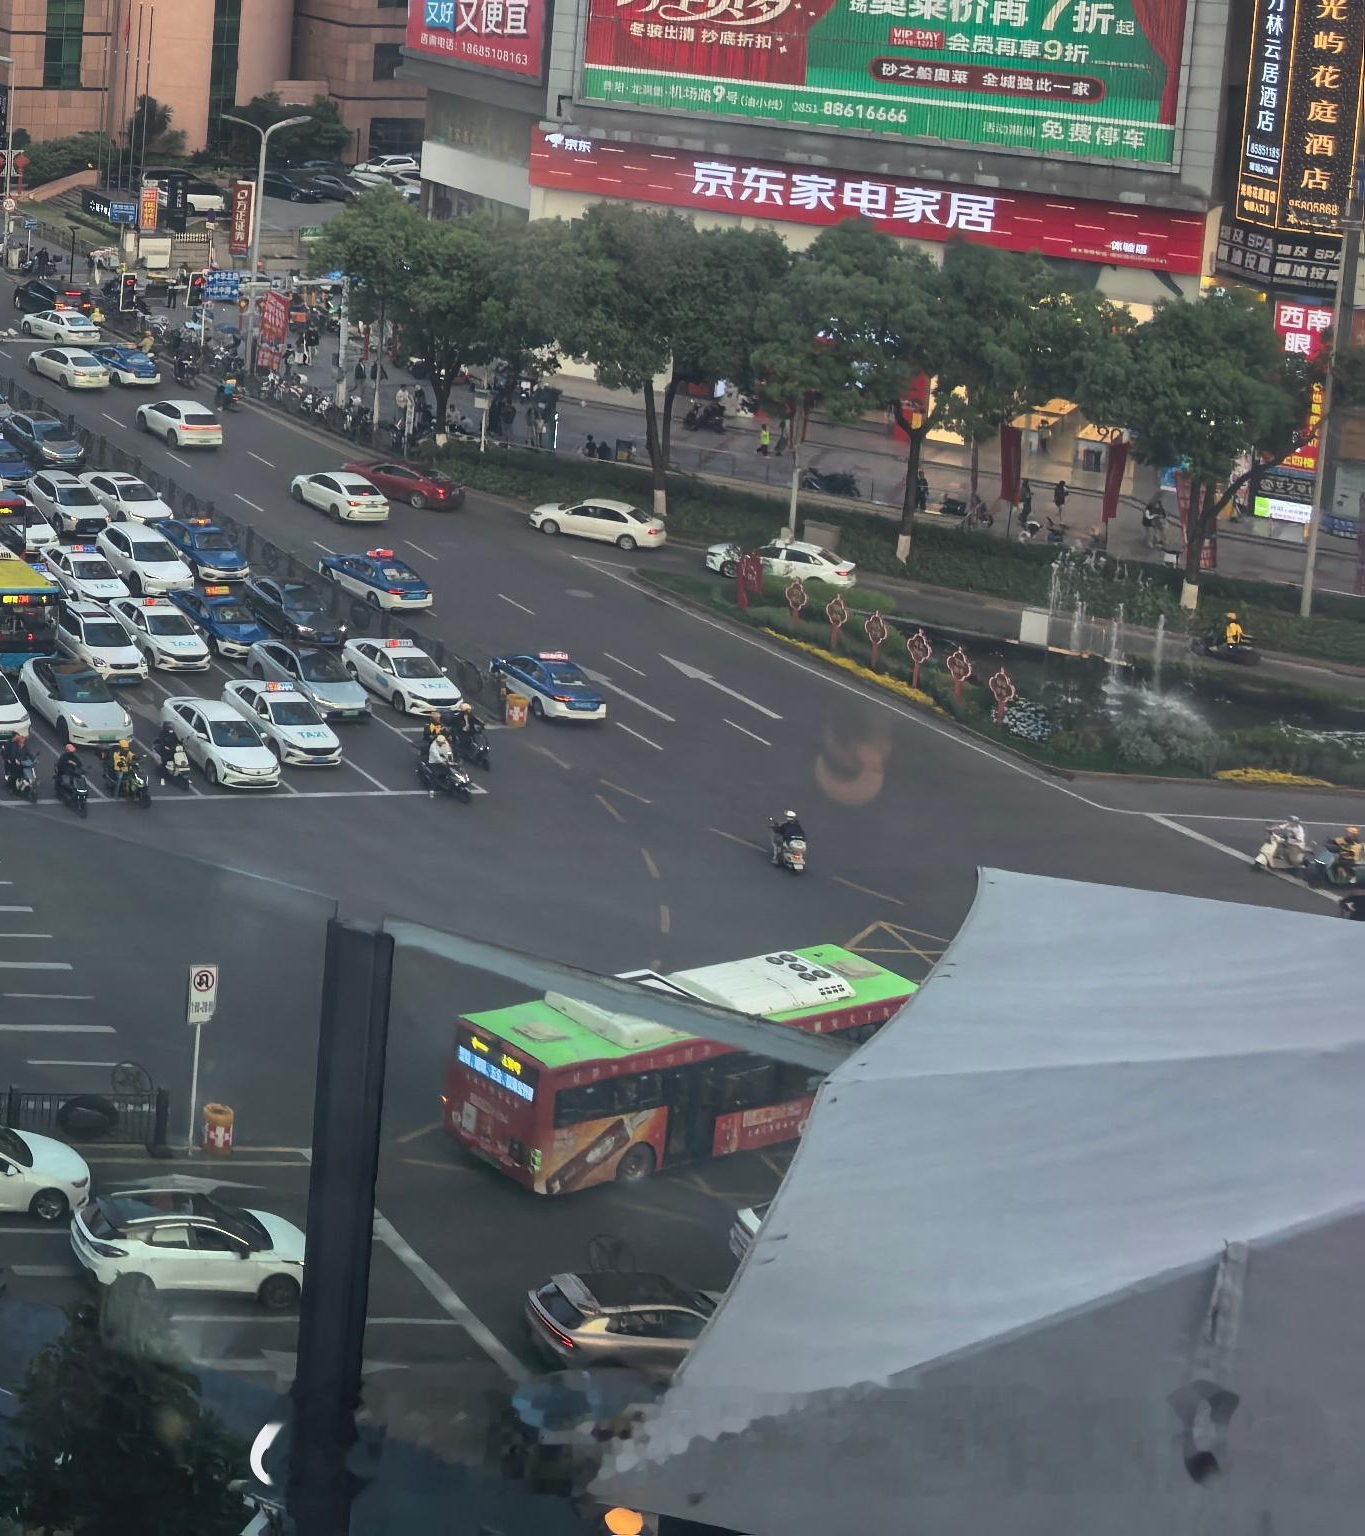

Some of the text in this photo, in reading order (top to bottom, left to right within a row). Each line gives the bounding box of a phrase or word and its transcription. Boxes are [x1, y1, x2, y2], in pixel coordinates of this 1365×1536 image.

[425, 1, 455, 24] 又好
[893, 27, 941, 41] VIP DAY
[946, 32, 1089, 64] 会员再享9折
[981, 72, 1091, 97] 全城独此一家
[564, 138, 592, 154] 京东
[1040, 119, 1146, 150] 免费停车
[692, 161, 996, 233] 京东家电家居
[1279, 305, 1333, 332] 西南
[1284, 331, 1312, 356] 眼
[297, 729, 329, 739] TAXI
